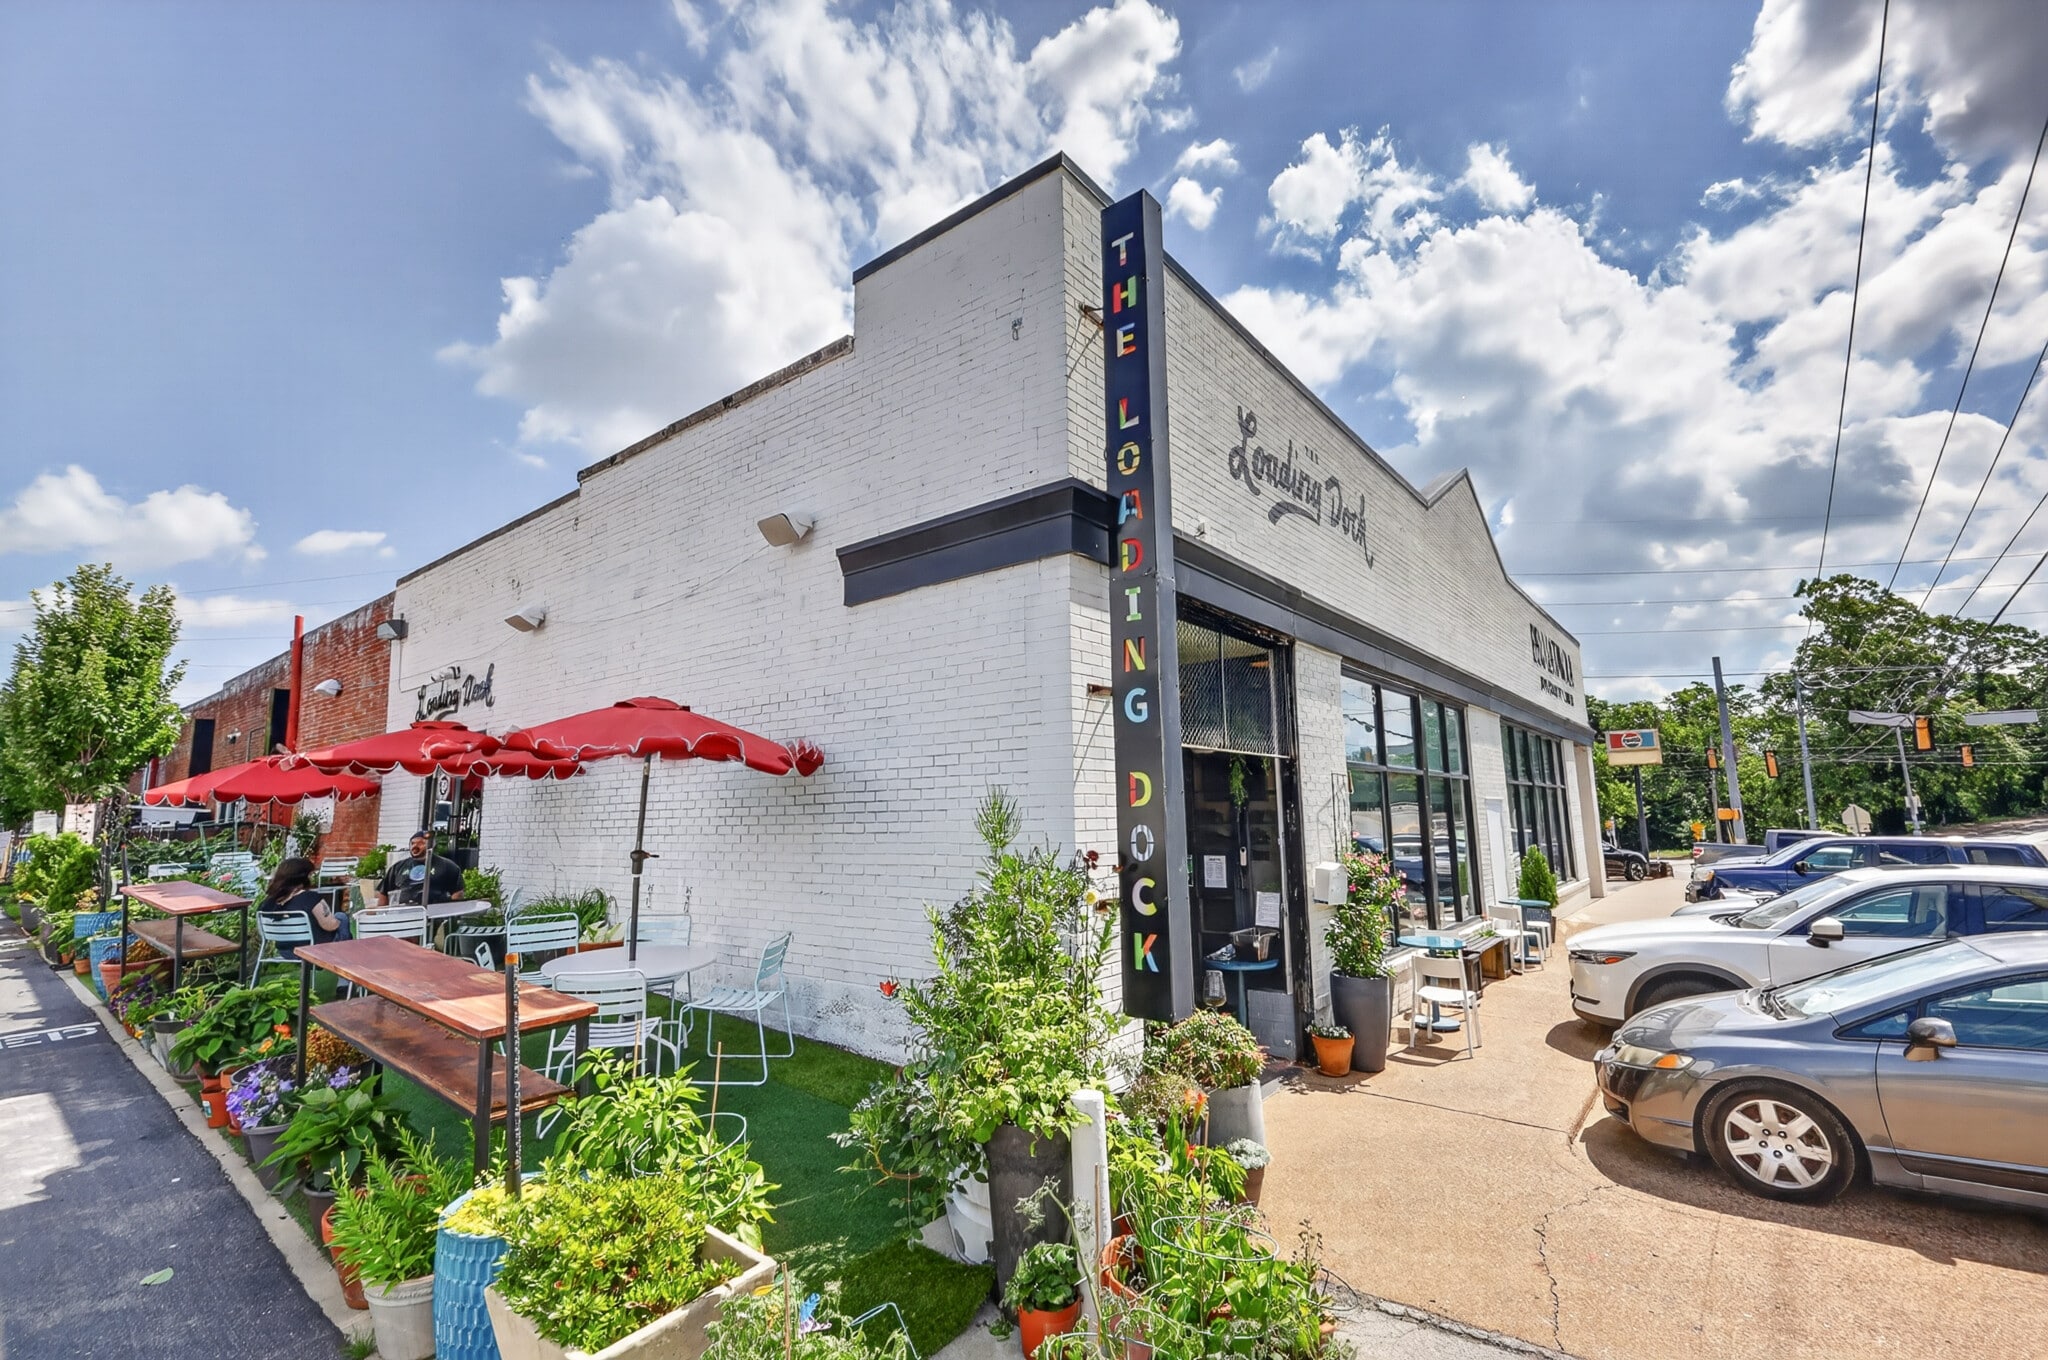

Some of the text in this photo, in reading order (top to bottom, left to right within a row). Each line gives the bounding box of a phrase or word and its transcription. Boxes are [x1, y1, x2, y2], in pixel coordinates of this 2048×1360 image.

[1111, 231, 1160, 973] THE LOADING DOCK
[1325, 475, 1374, 570] Dock
